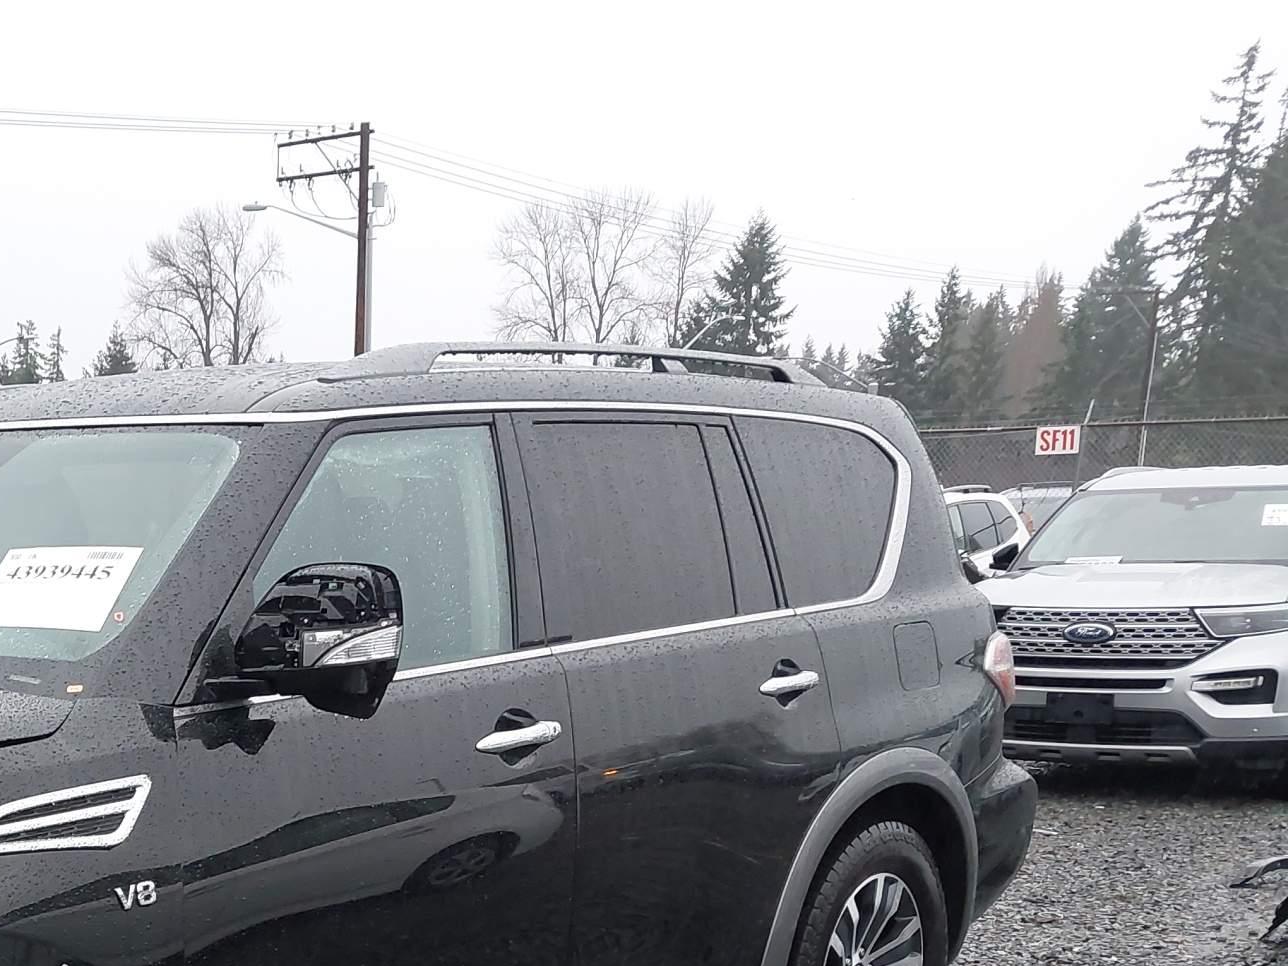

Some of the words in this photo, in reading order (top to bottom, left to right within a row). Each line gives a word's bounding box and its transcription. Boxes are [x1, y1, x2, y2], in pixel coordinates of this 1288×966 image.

[1040, 429, 1075, 451] SF11
[7, 565, 114, 580] 43939445
[114, 880, 157, 910] V8
